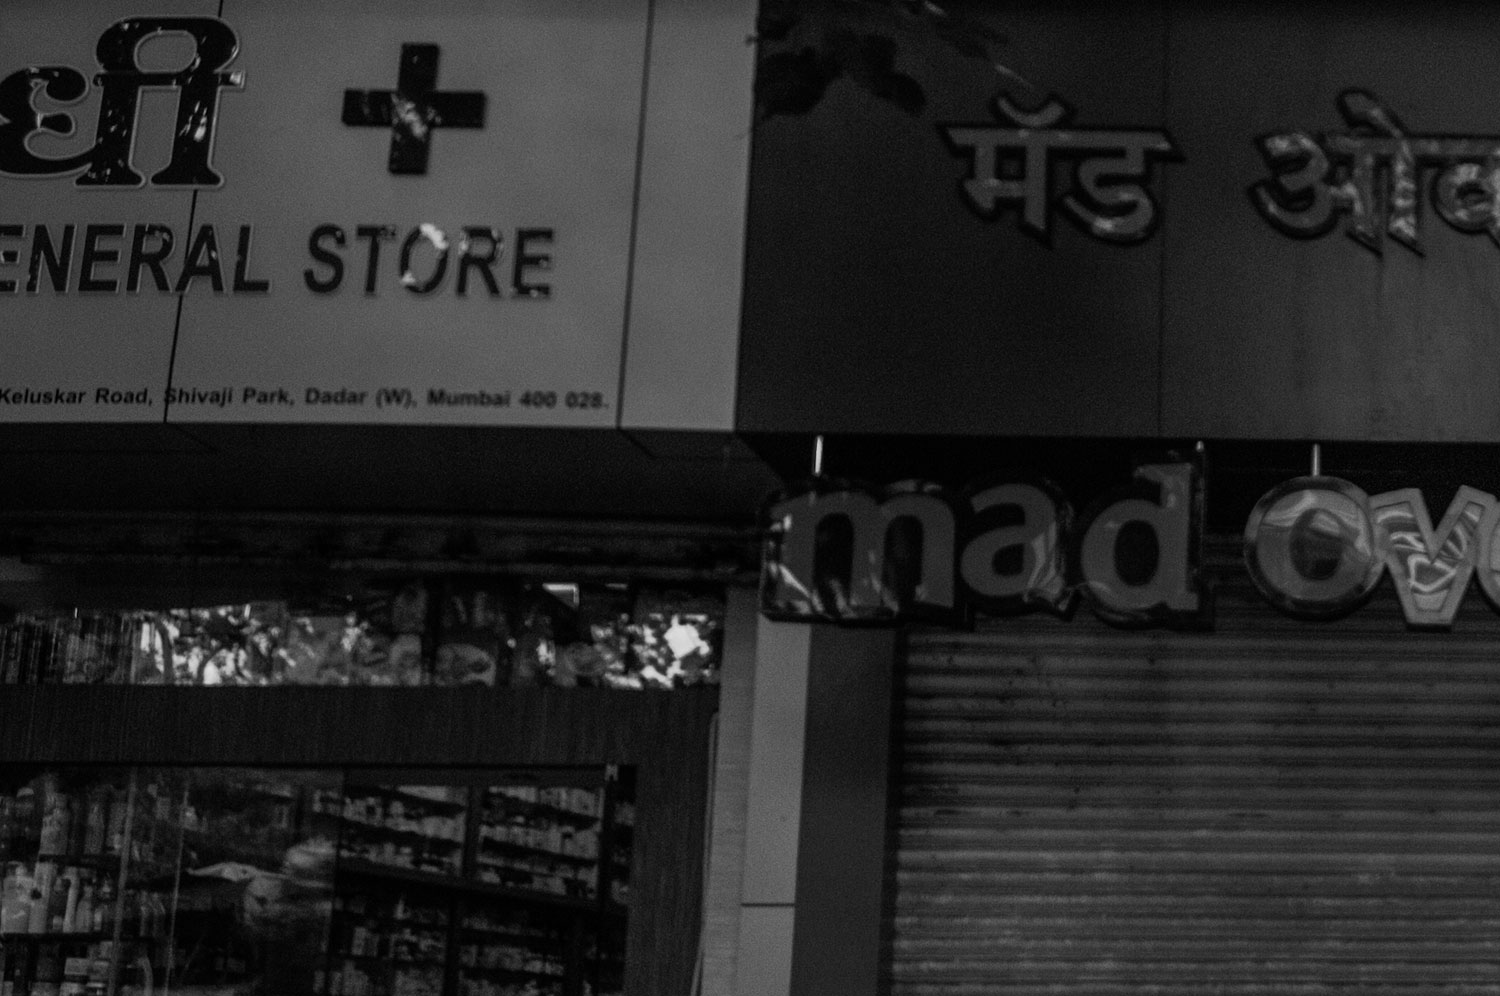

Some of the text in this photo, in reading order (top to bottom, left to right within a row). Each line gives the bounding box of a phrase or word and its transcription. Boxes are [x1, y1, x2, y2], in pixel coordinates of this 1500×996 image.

[303, 224, 554, 297] STORE
[0, 388, 86, 405] Keluskar
[95, 388, 152, 406] Road,
[165, 388, 233, 408] Shivaji
[243, 388, 295, 406] Park,
[305, 388, 368, 405] Dadar
[376, 388, 417, 409] (W),
[427, 389, 511, 407] Mumbai
[519, 391, 557, 408] 400
[761, 460, 1213, 630] mad
